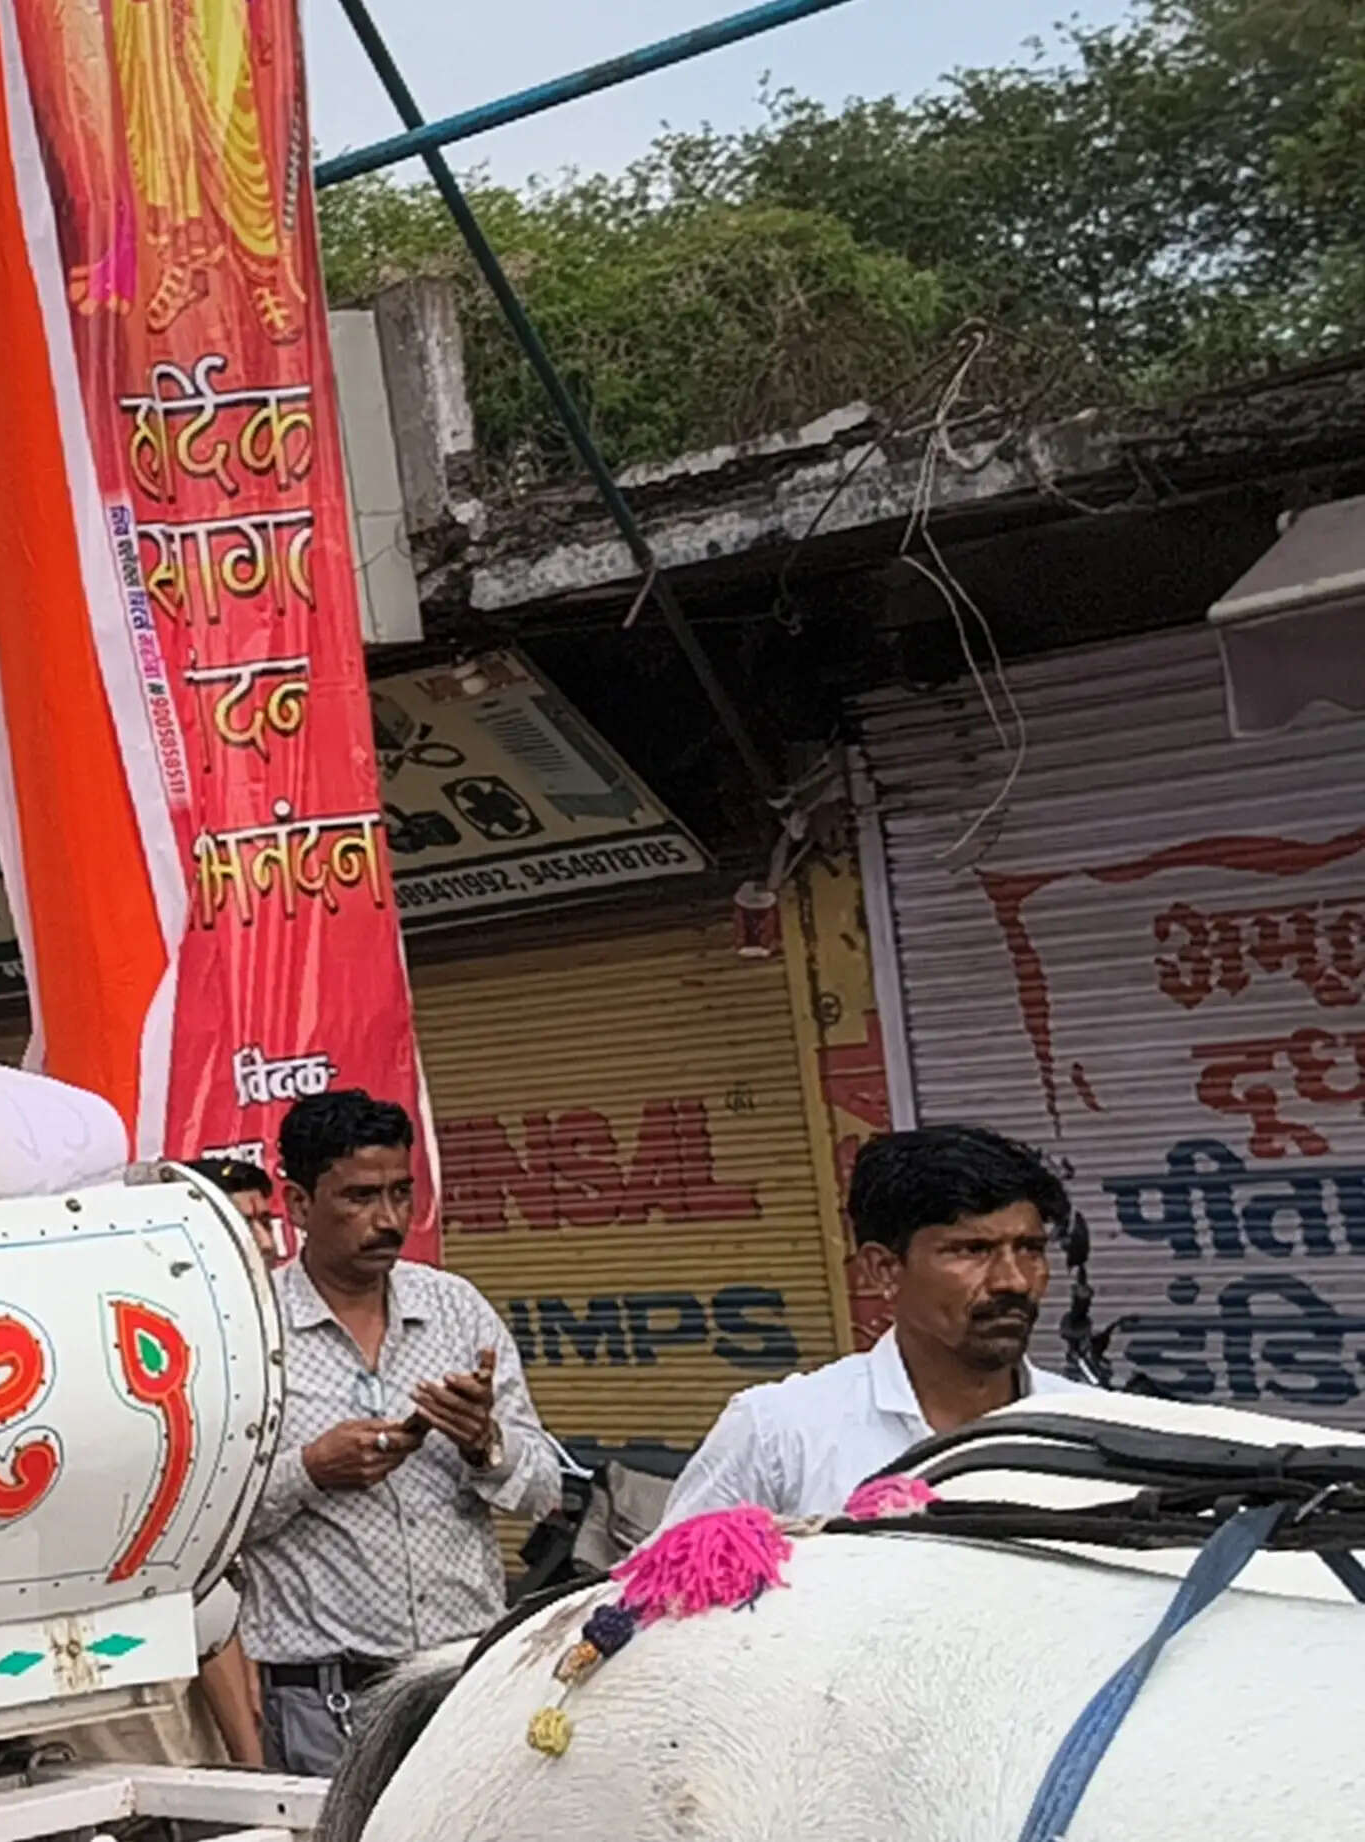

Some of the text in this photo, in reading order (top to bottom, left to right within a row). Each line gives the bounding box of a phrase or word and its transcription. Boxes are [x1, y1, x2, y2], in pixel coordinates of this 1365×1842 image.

[435, 1097, 763, 1234] NSAL
[509, 1284, 801, 1373] MPS
[1119, 1273, 1365, 1406] इंडि
